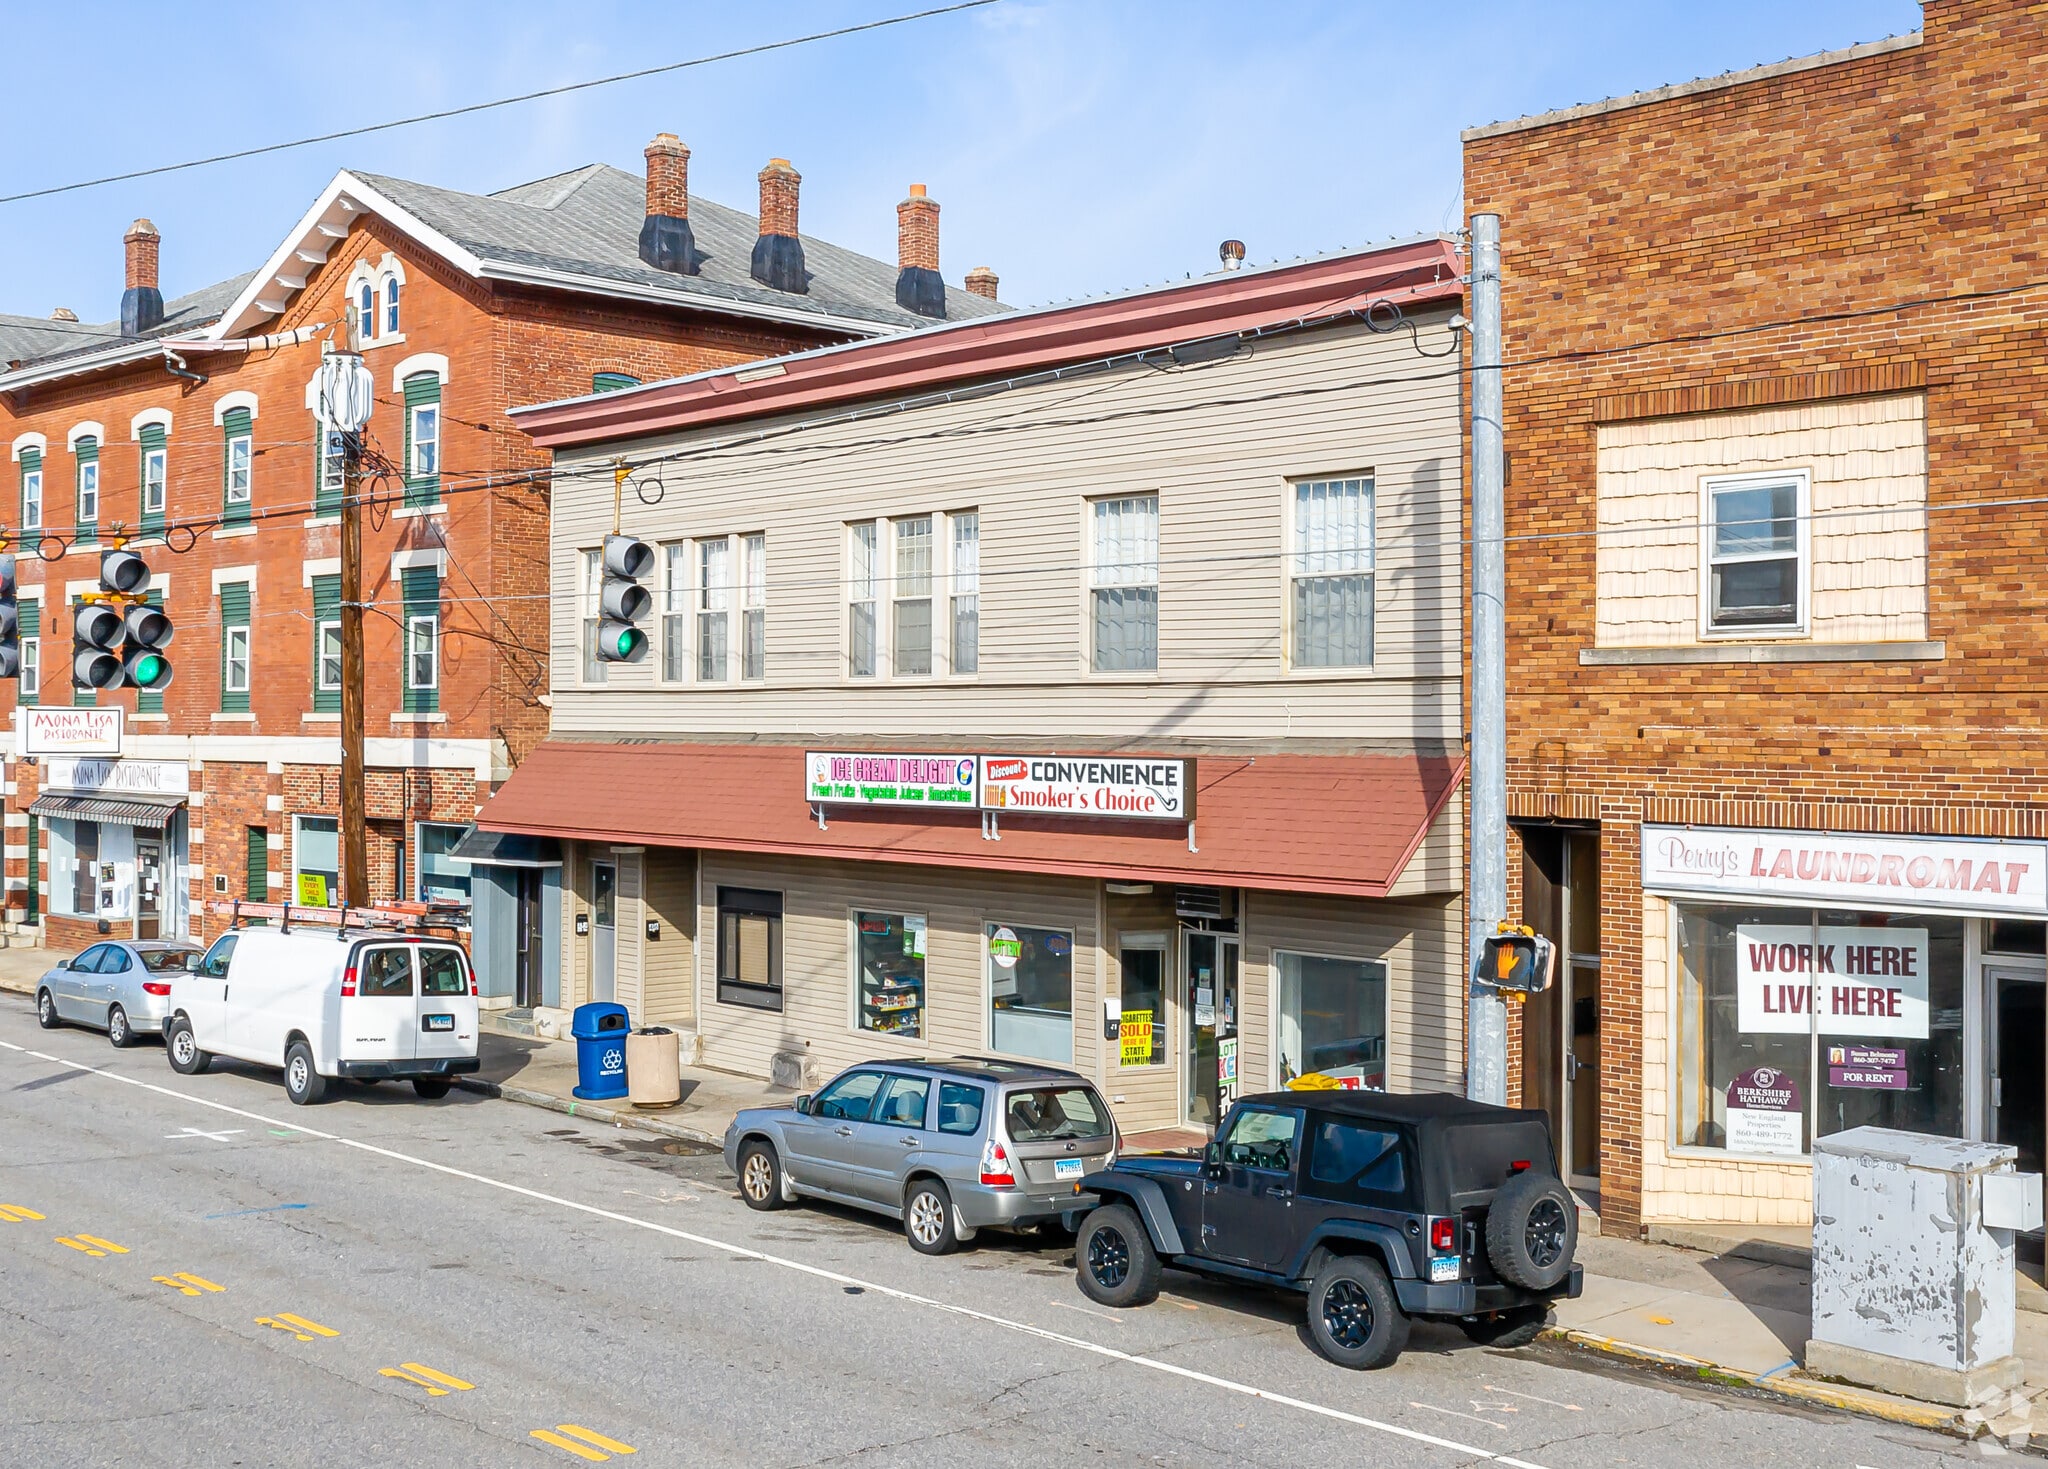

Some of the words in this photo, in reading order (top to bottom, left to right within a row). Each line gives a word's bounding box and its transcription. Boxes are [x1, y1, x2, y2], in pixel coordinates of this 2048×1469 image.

[35, 712, 80, 727] MONA
[71, 765, 94, 785] MONA
[830, 757, 852, 781] ICE
[853, 757, 897, 782] CREAM
[899, 758, 956, 785] DELIGHT
[989, 761, 1022, 780] Discount
[1031, 761, 1177, 787] CONVENIENCE
[811, 782, 833, 797] Fresh
[834, 783, 856, 798] Fruits
[859, 784, 897, 802] Vegetable
[899, 785, 924, 800] Juices
[928, 786, 972, 803] Smoothies
[1010, 784, 1088, 809] Smoker's
[1094, 786, 1155, 812] Choice
[1657, 836, 1739, 879] Perry's
[1749, 846, 2030, 895] LAUNDROMAT
[990, 938, 1023, 958] LOTTERY
[1748, 943, 1836, 974] WORK
[1846, 945, 1918, 977] HERE
[1832, 986, 1902, 1017] HERE
[1120, 1023, 1151, 1037] SOLD
[1125, 1046, 1145, 1056] STATE
[1843, 1072, 1864, 1082] FOR
[1865, 1073, 1894, 1083] RENT
[1737, 1087, 1792, 1098] BERKSHIRE
[1740, 1095, 1790, 1106] HATHAWAY
